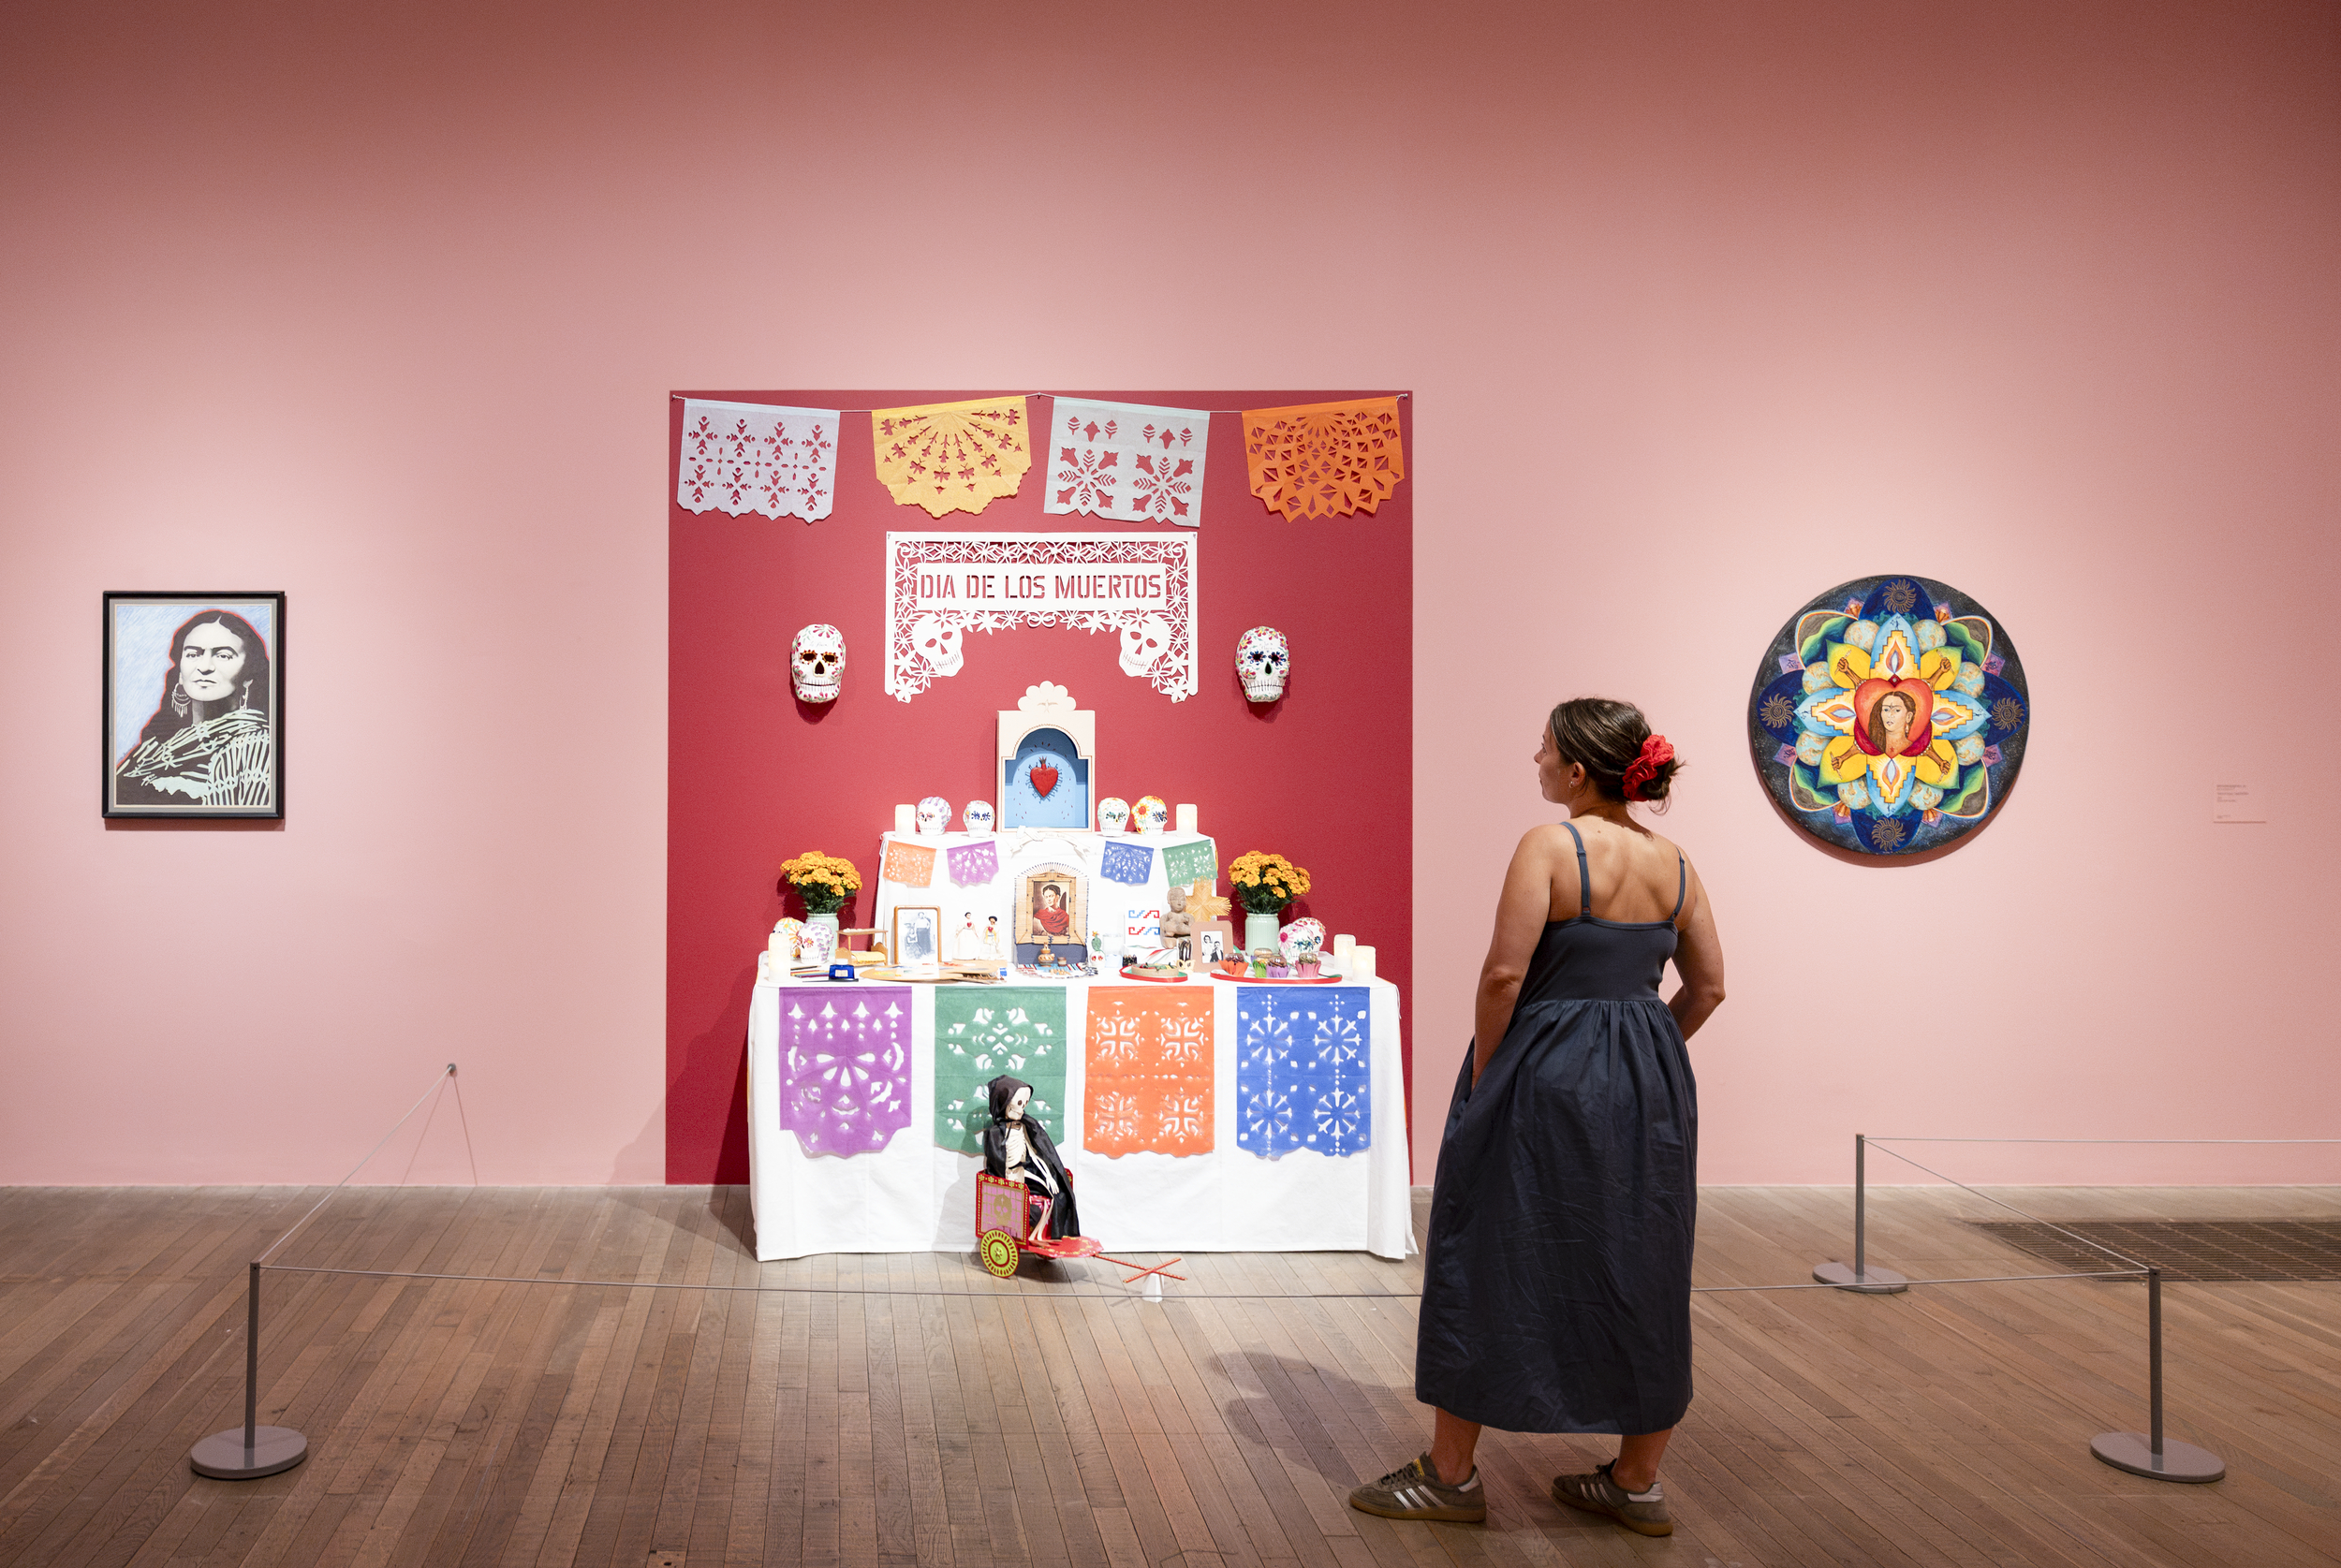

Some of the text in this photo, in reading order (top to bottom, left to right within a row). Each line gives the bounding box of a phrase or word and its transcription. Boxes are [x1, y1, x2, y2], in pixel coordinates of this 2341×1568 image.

[920, 575, 1161, 599] DIA DE LOS MUERTOS
